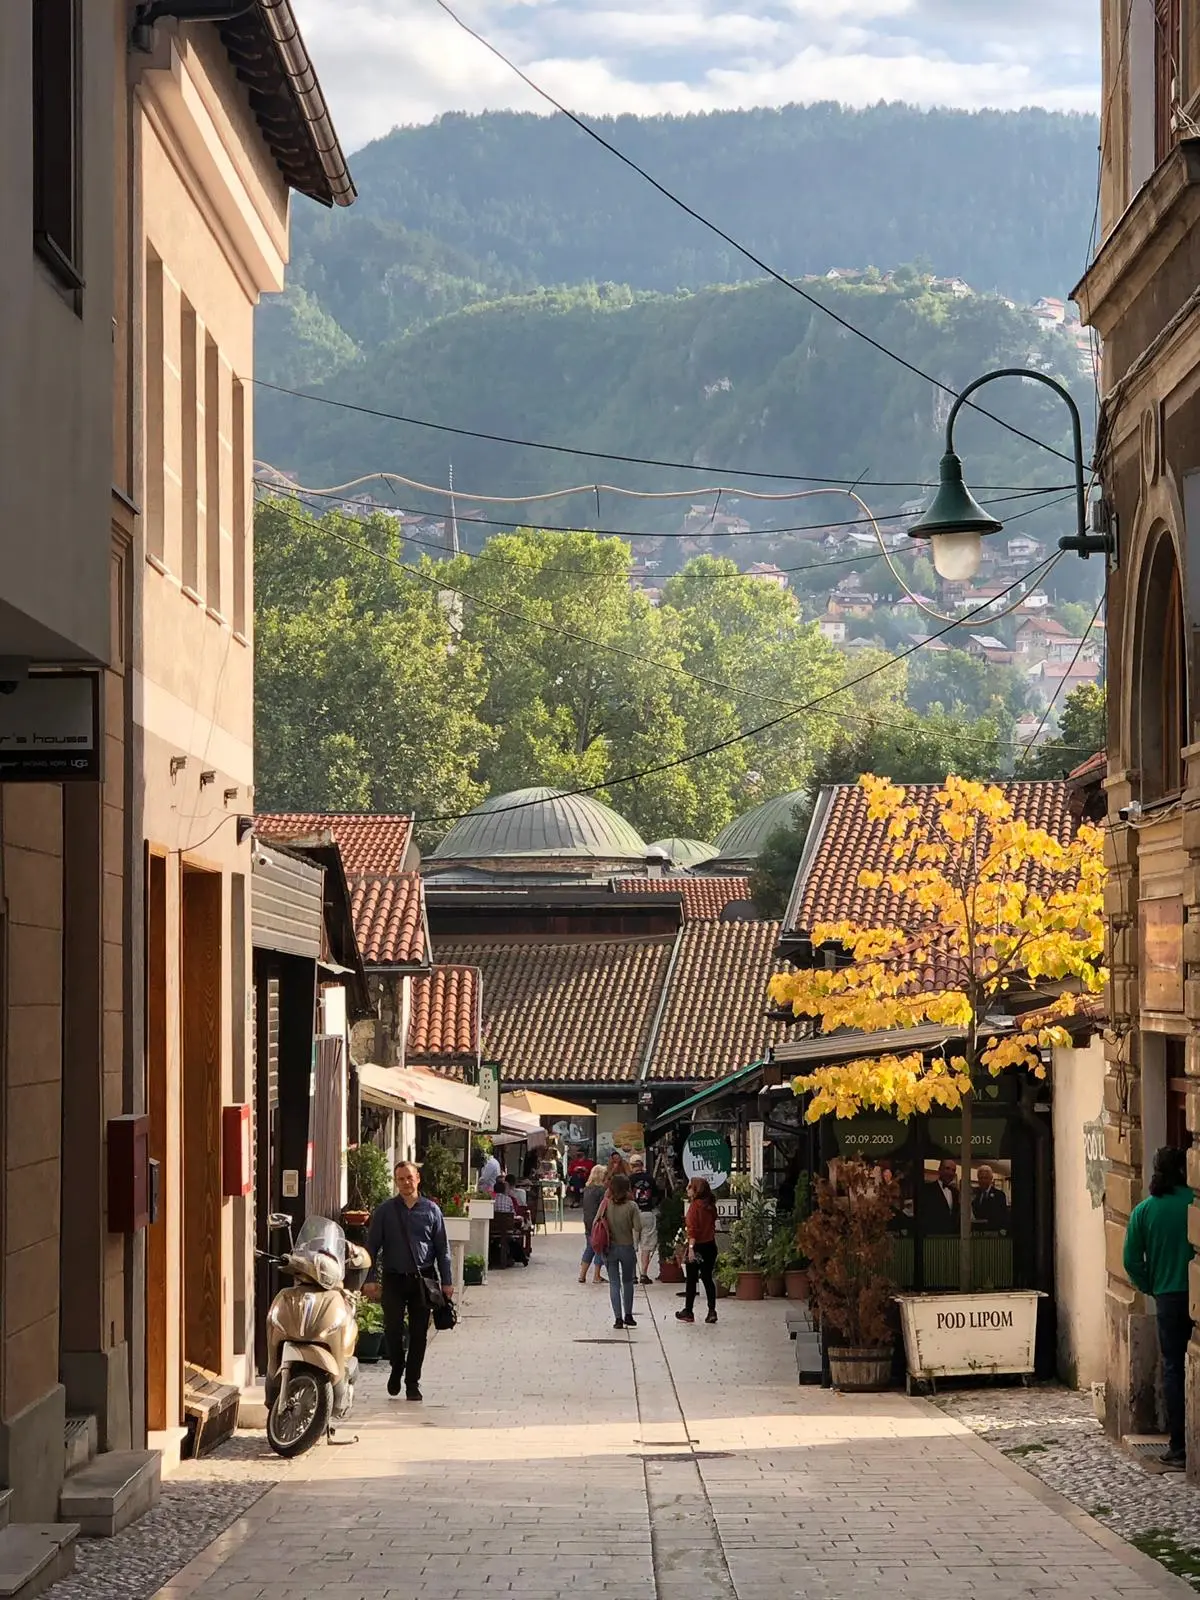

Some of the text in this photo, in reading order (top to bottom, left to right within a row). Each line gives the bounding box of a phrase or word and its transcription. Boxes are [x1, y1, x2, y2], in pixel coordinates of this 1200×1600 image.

[33, 732, 88, 744] house
[71, 759, 88, 768] UGG
[689, 1138, 721, 1148] RESTORAN
[844, 1134, 894, 1145] 20.09.2003
[943, 1134, 992, 1145] 11.02015
[936, 1310, 1013, 1329] POD LIPOM
